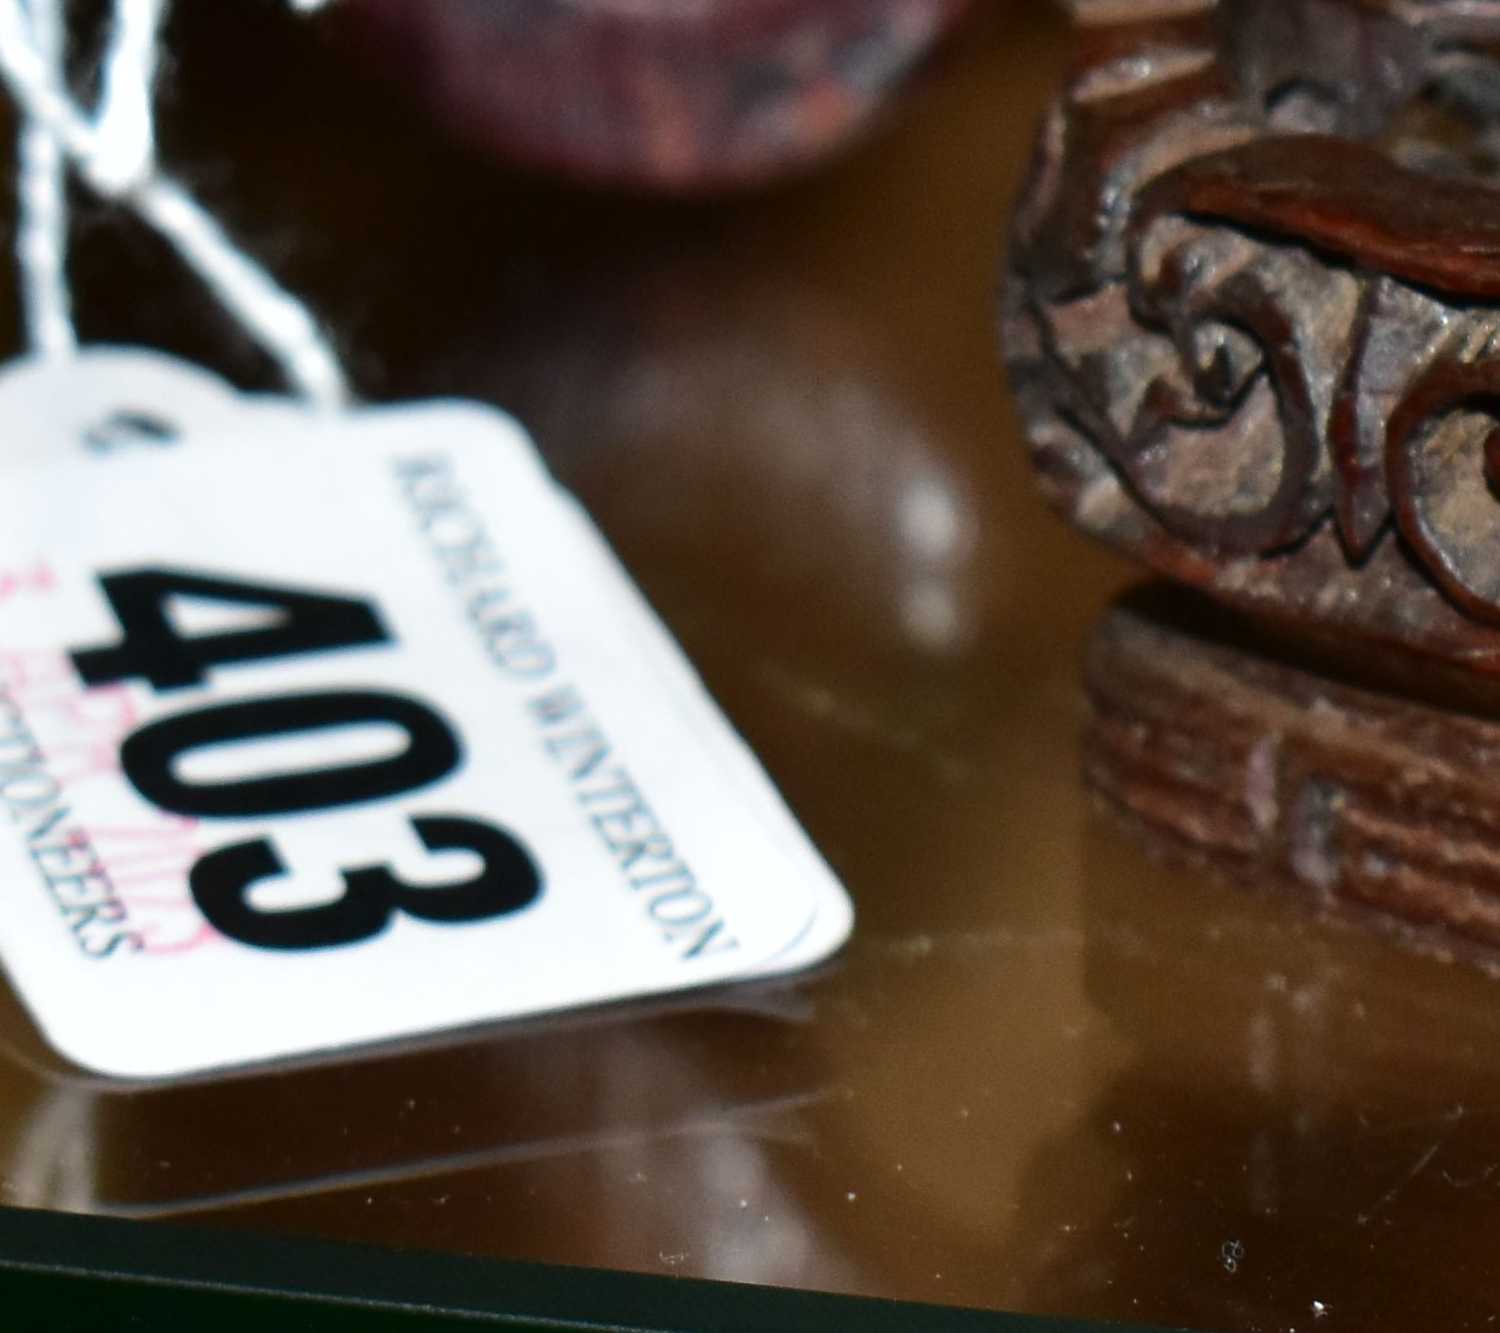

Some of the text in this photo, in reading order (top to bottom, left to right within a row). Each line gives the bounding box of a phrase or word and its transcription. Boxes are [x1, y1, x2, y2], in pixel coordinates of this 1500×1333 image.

[66, 562, 547, 955] 403
[390, 447, 741, 961] RICHARD WINTERTON
